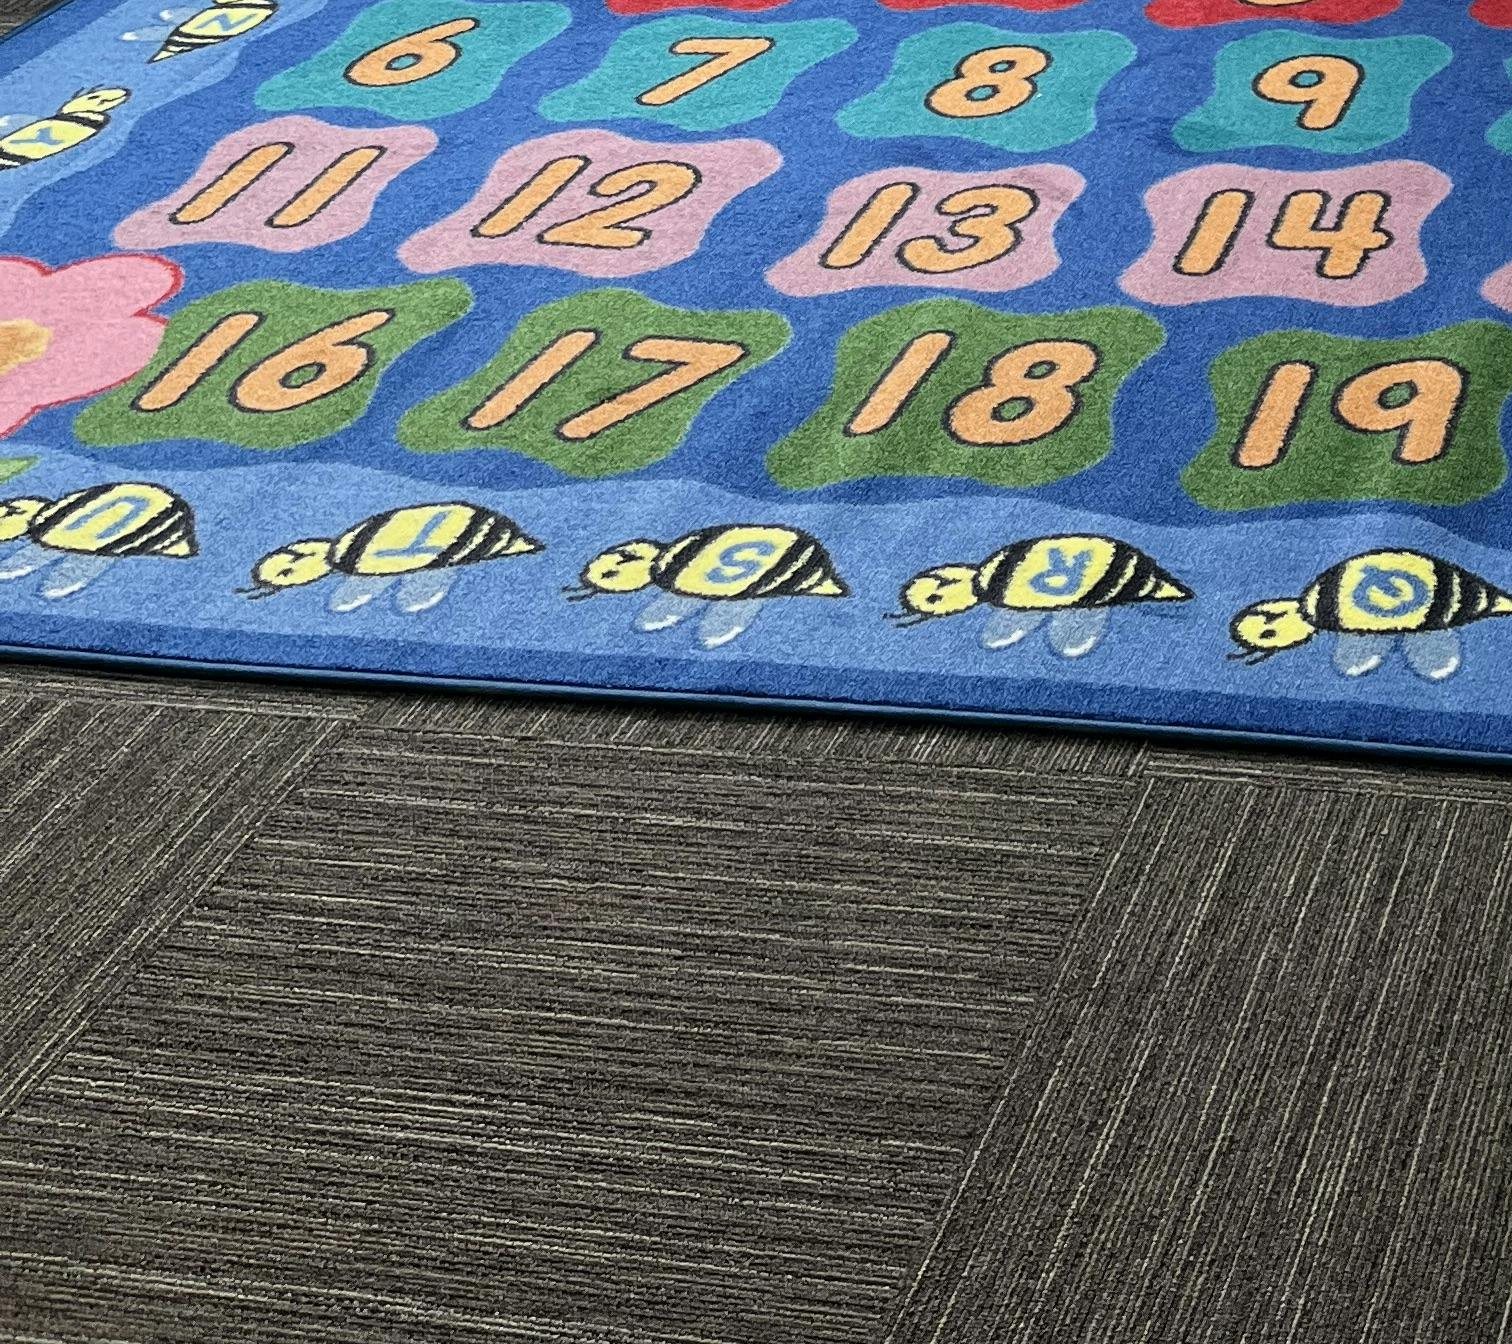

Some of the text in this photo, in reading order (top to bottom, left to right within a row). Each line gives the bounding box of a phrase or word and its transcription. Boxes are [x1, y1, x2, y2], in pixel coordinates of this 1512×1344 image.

[343, 17, 481, 88] 6
[634, 35, 777, 107] 7
[923, 43, 1053, 119] 8
[1252, 53, 1366, 133] 9
[168, 142, 388, 230] 11
[470, 155, 703, 250] 12
[820, 181, 1040, 274] 13
[1173, 188, 1395, 280] 14
[129, 308, 396, 414] 16
[461, 328, 748, 442] 17
[843, 329, 1100, 448] 18
[1232, 356, 1469, 471] 19
[372, 511, 464, 558] T
[717, 540, 775, 583] S
[1027, 546, 1094, 596] R
[1351, 565, 1433, 618] Q
